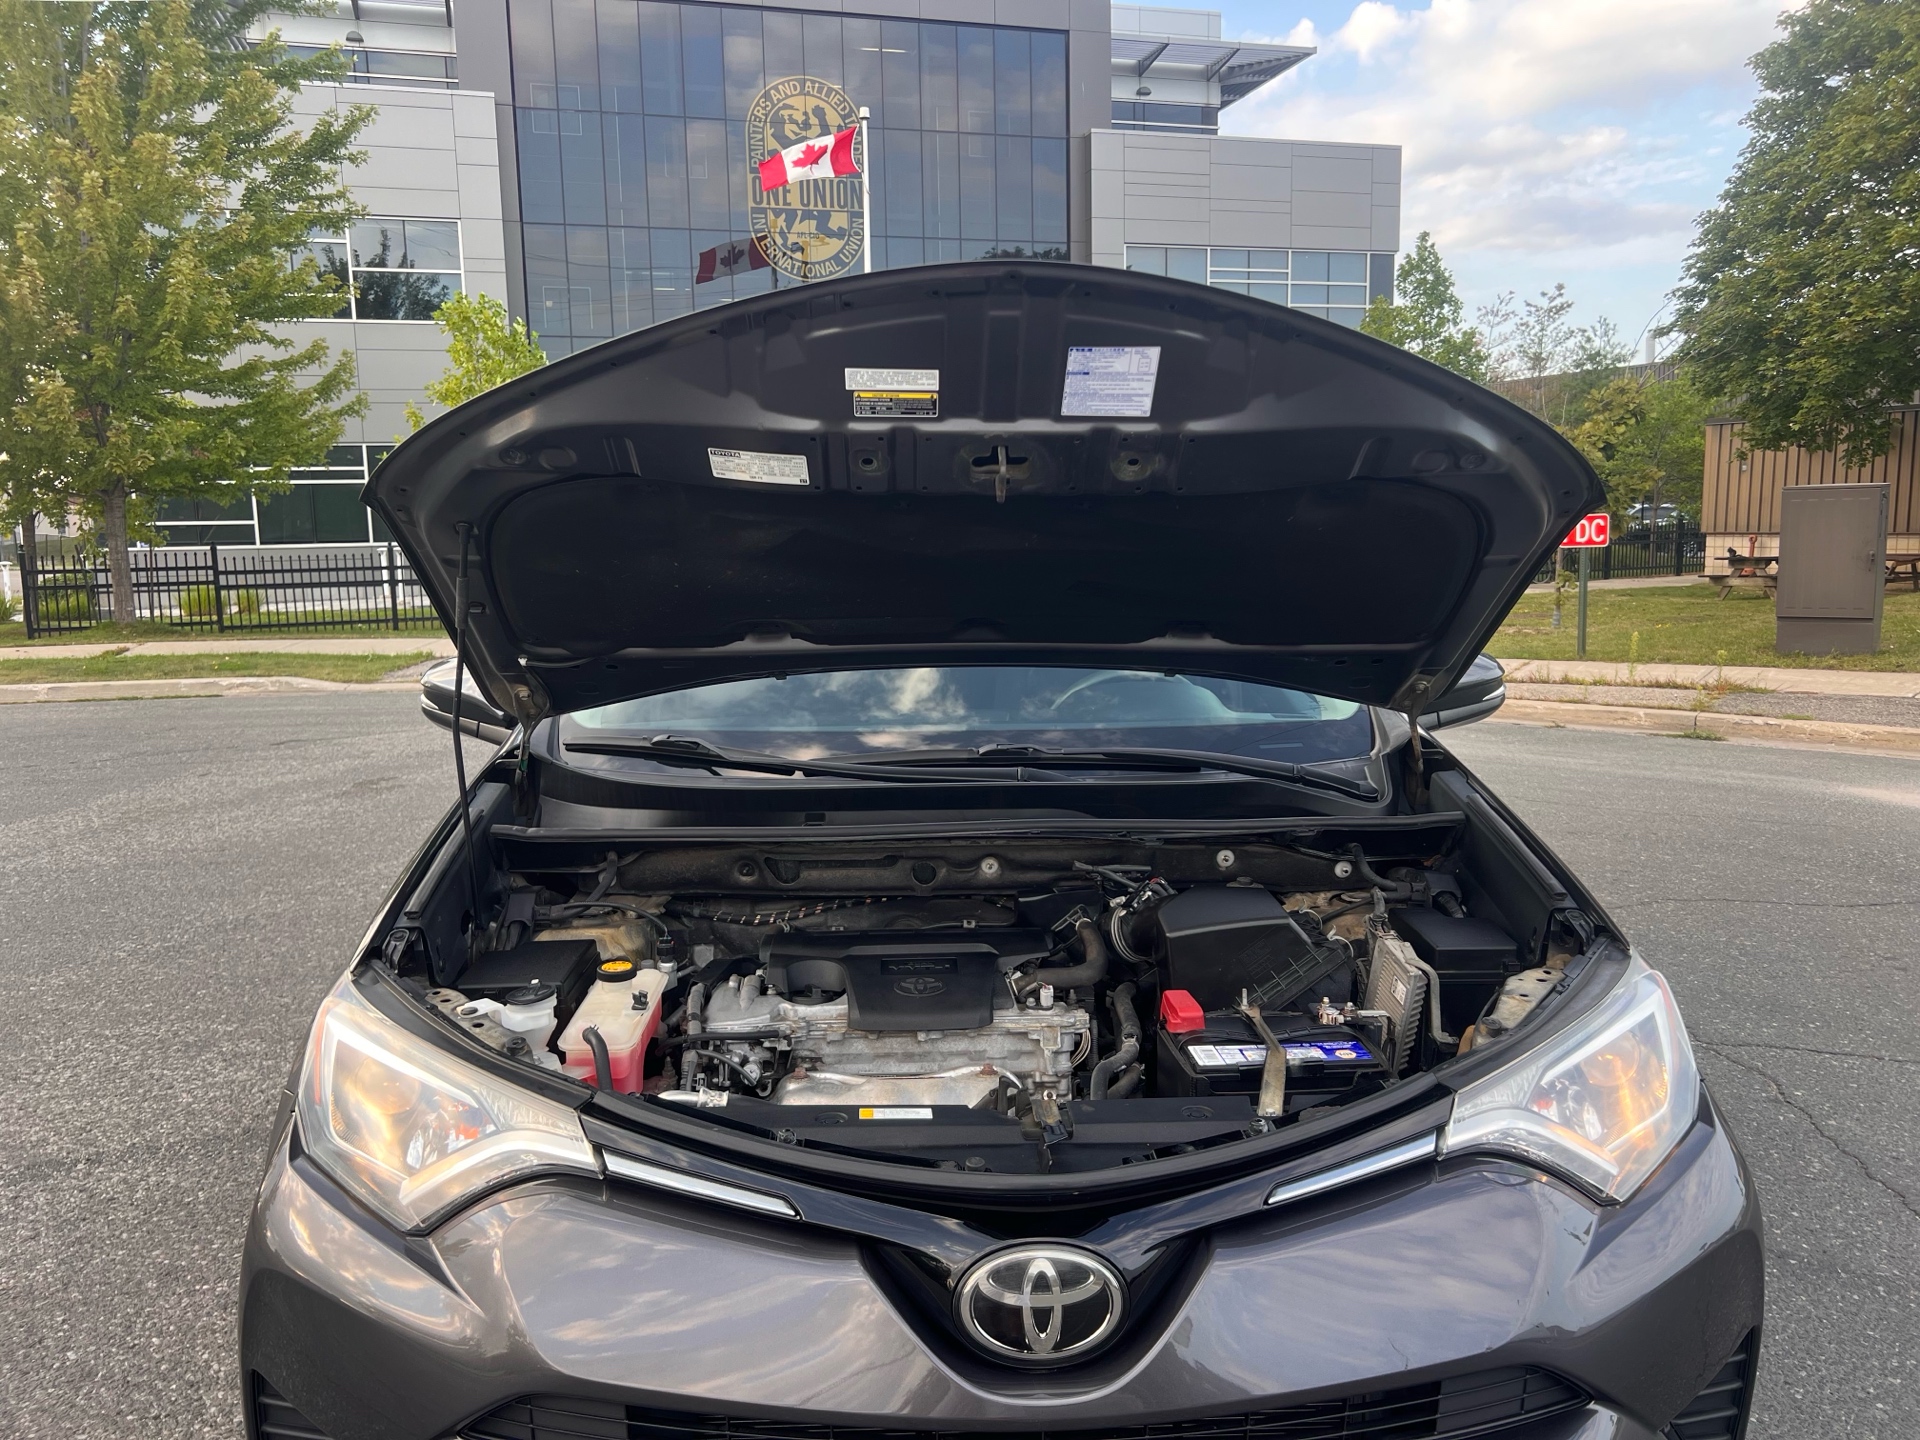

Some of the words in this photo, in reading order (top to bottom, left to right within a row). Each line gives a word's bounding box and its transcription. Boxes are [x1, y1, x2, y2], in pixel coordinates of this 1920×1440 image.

[750, 98, 772, 167] PAINTERS
[770, 81, 801, 104] AND
[804, 81, 850, 115] ALLIED
[751, 175, 792, 206] ONE
[799, 178, 864, 210] UNION
[752, 213, 842, 277] INTERNATIONAL
[839, 218, 864, 263] UNION
[710, 450, 741, 458] TOYOTA
[1563, 518, 1605, 543] DC
